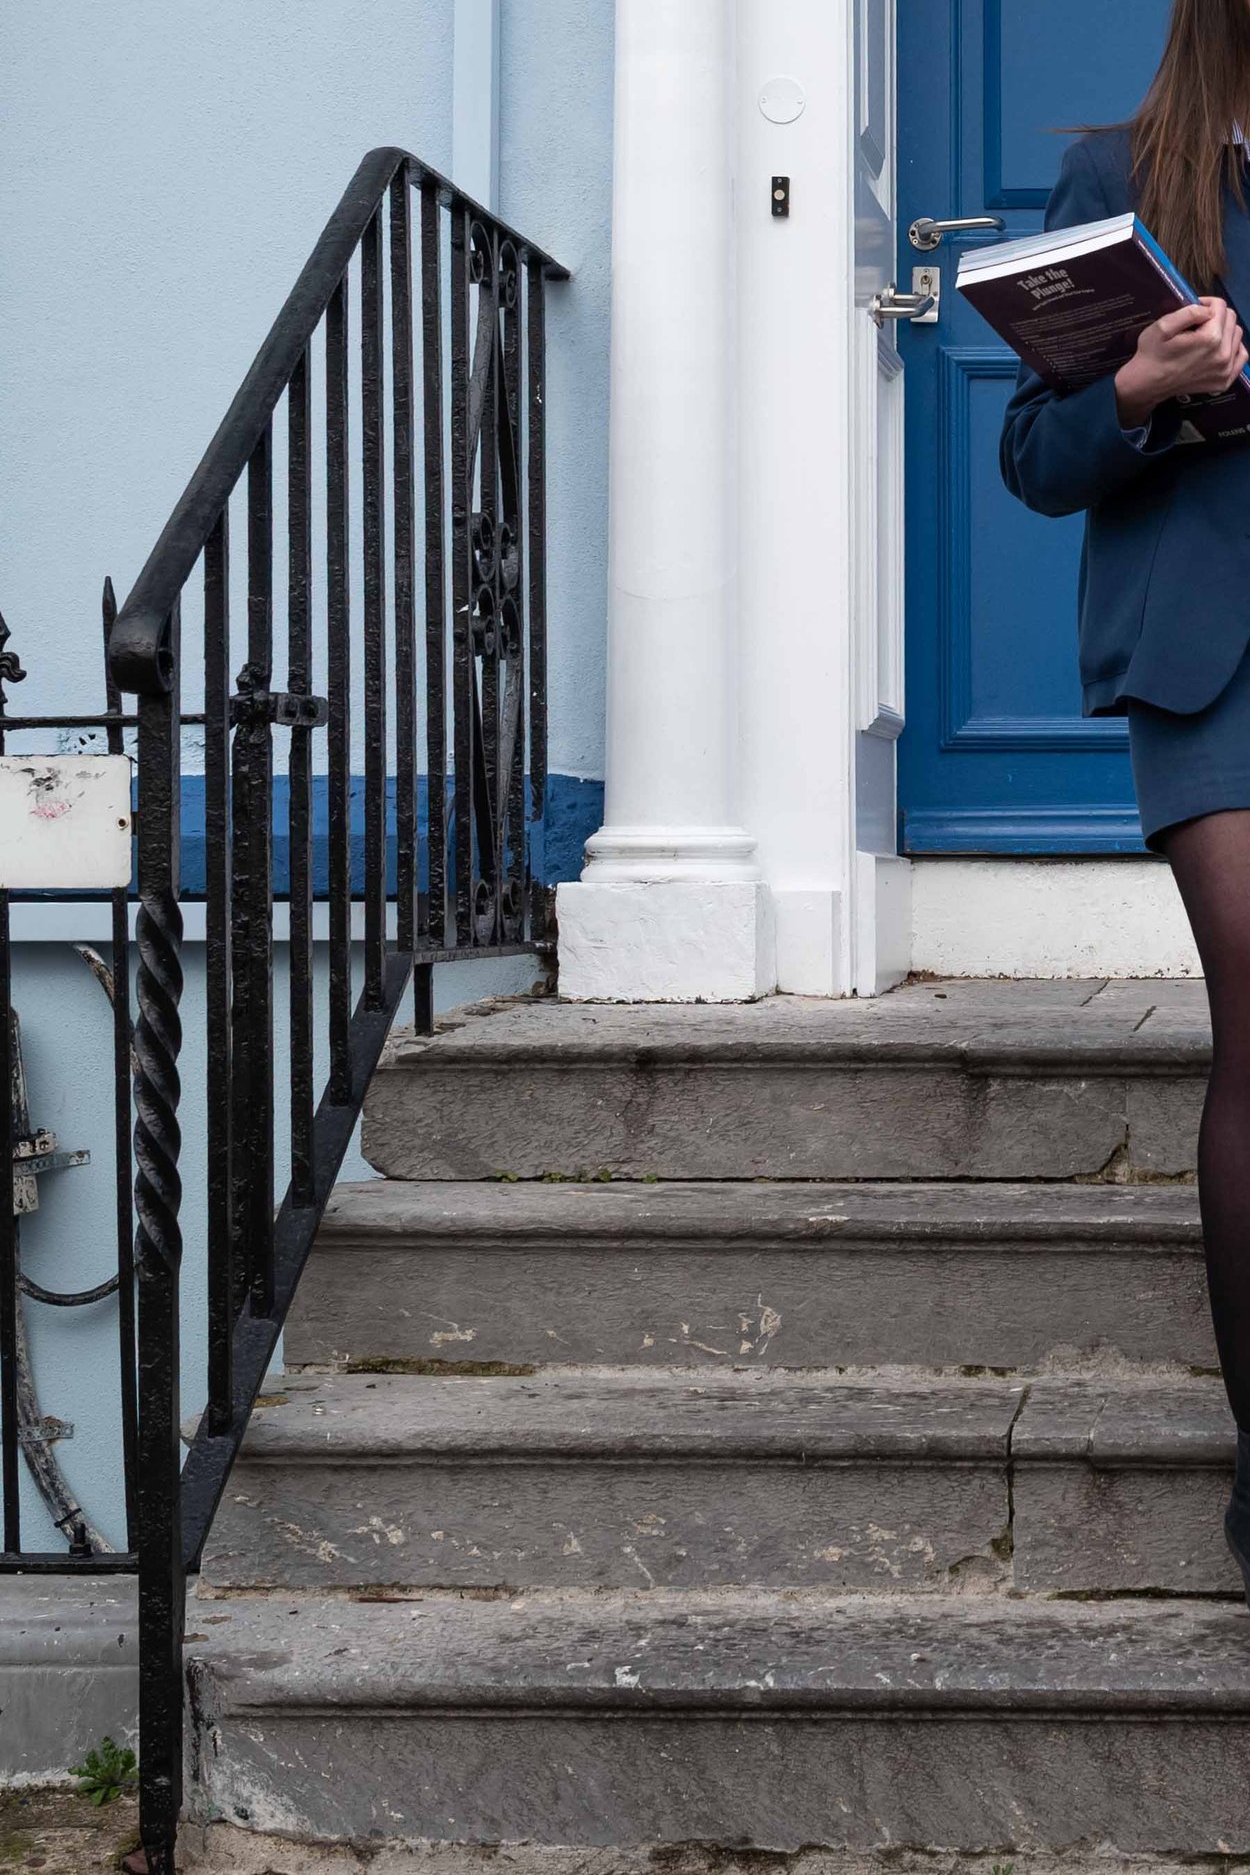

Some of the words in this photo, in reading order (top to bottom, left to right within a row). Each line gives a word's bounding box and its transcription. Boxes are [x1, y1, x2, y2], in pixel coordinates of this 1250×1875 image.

[1016, 275, 1048, 291] Take
[1045, 268, 1069, 281] the
[1030, 277, 1076, 300] Plunge!
